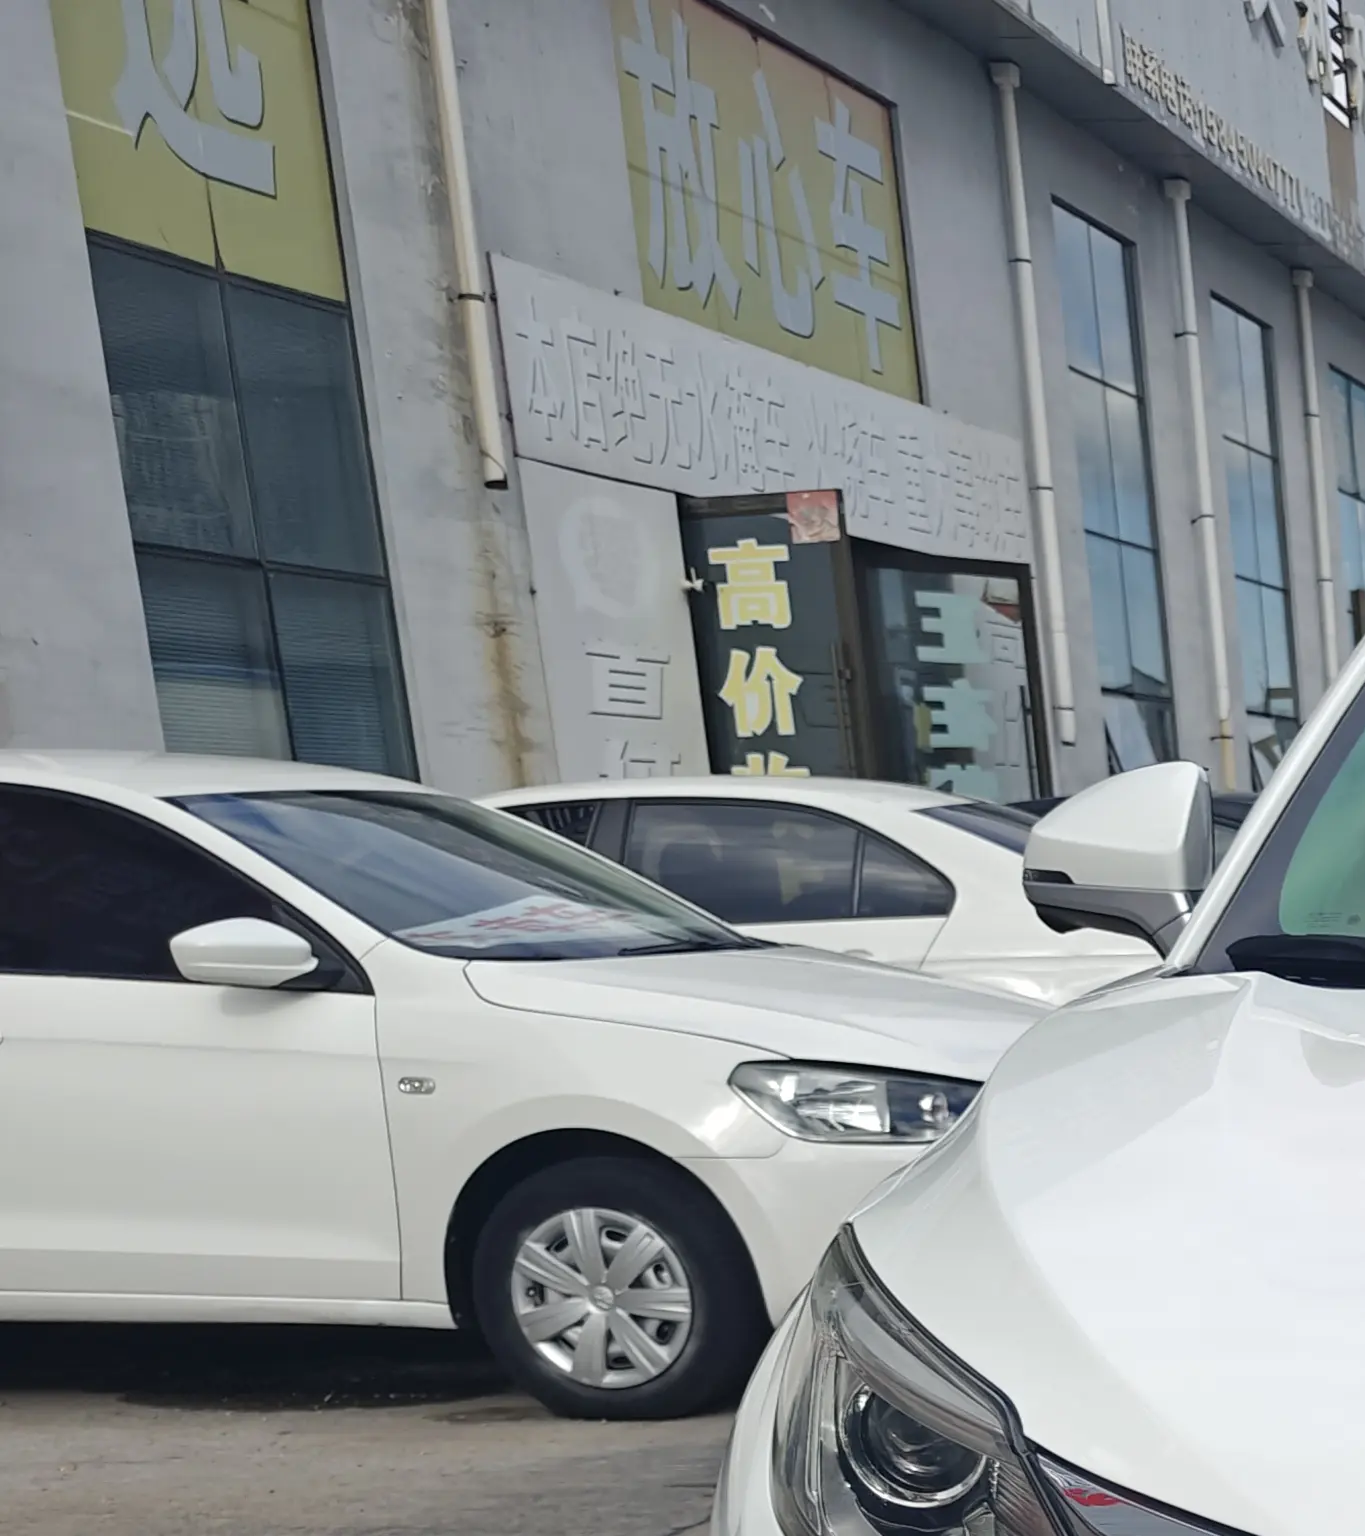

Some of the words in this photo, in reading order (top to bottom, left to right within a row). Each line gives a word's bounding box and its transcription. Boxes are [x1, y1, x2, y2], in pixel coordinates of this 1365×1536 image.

[620, 0, 901, 376] 放心车
[707, 537, 811, 777] 高价
